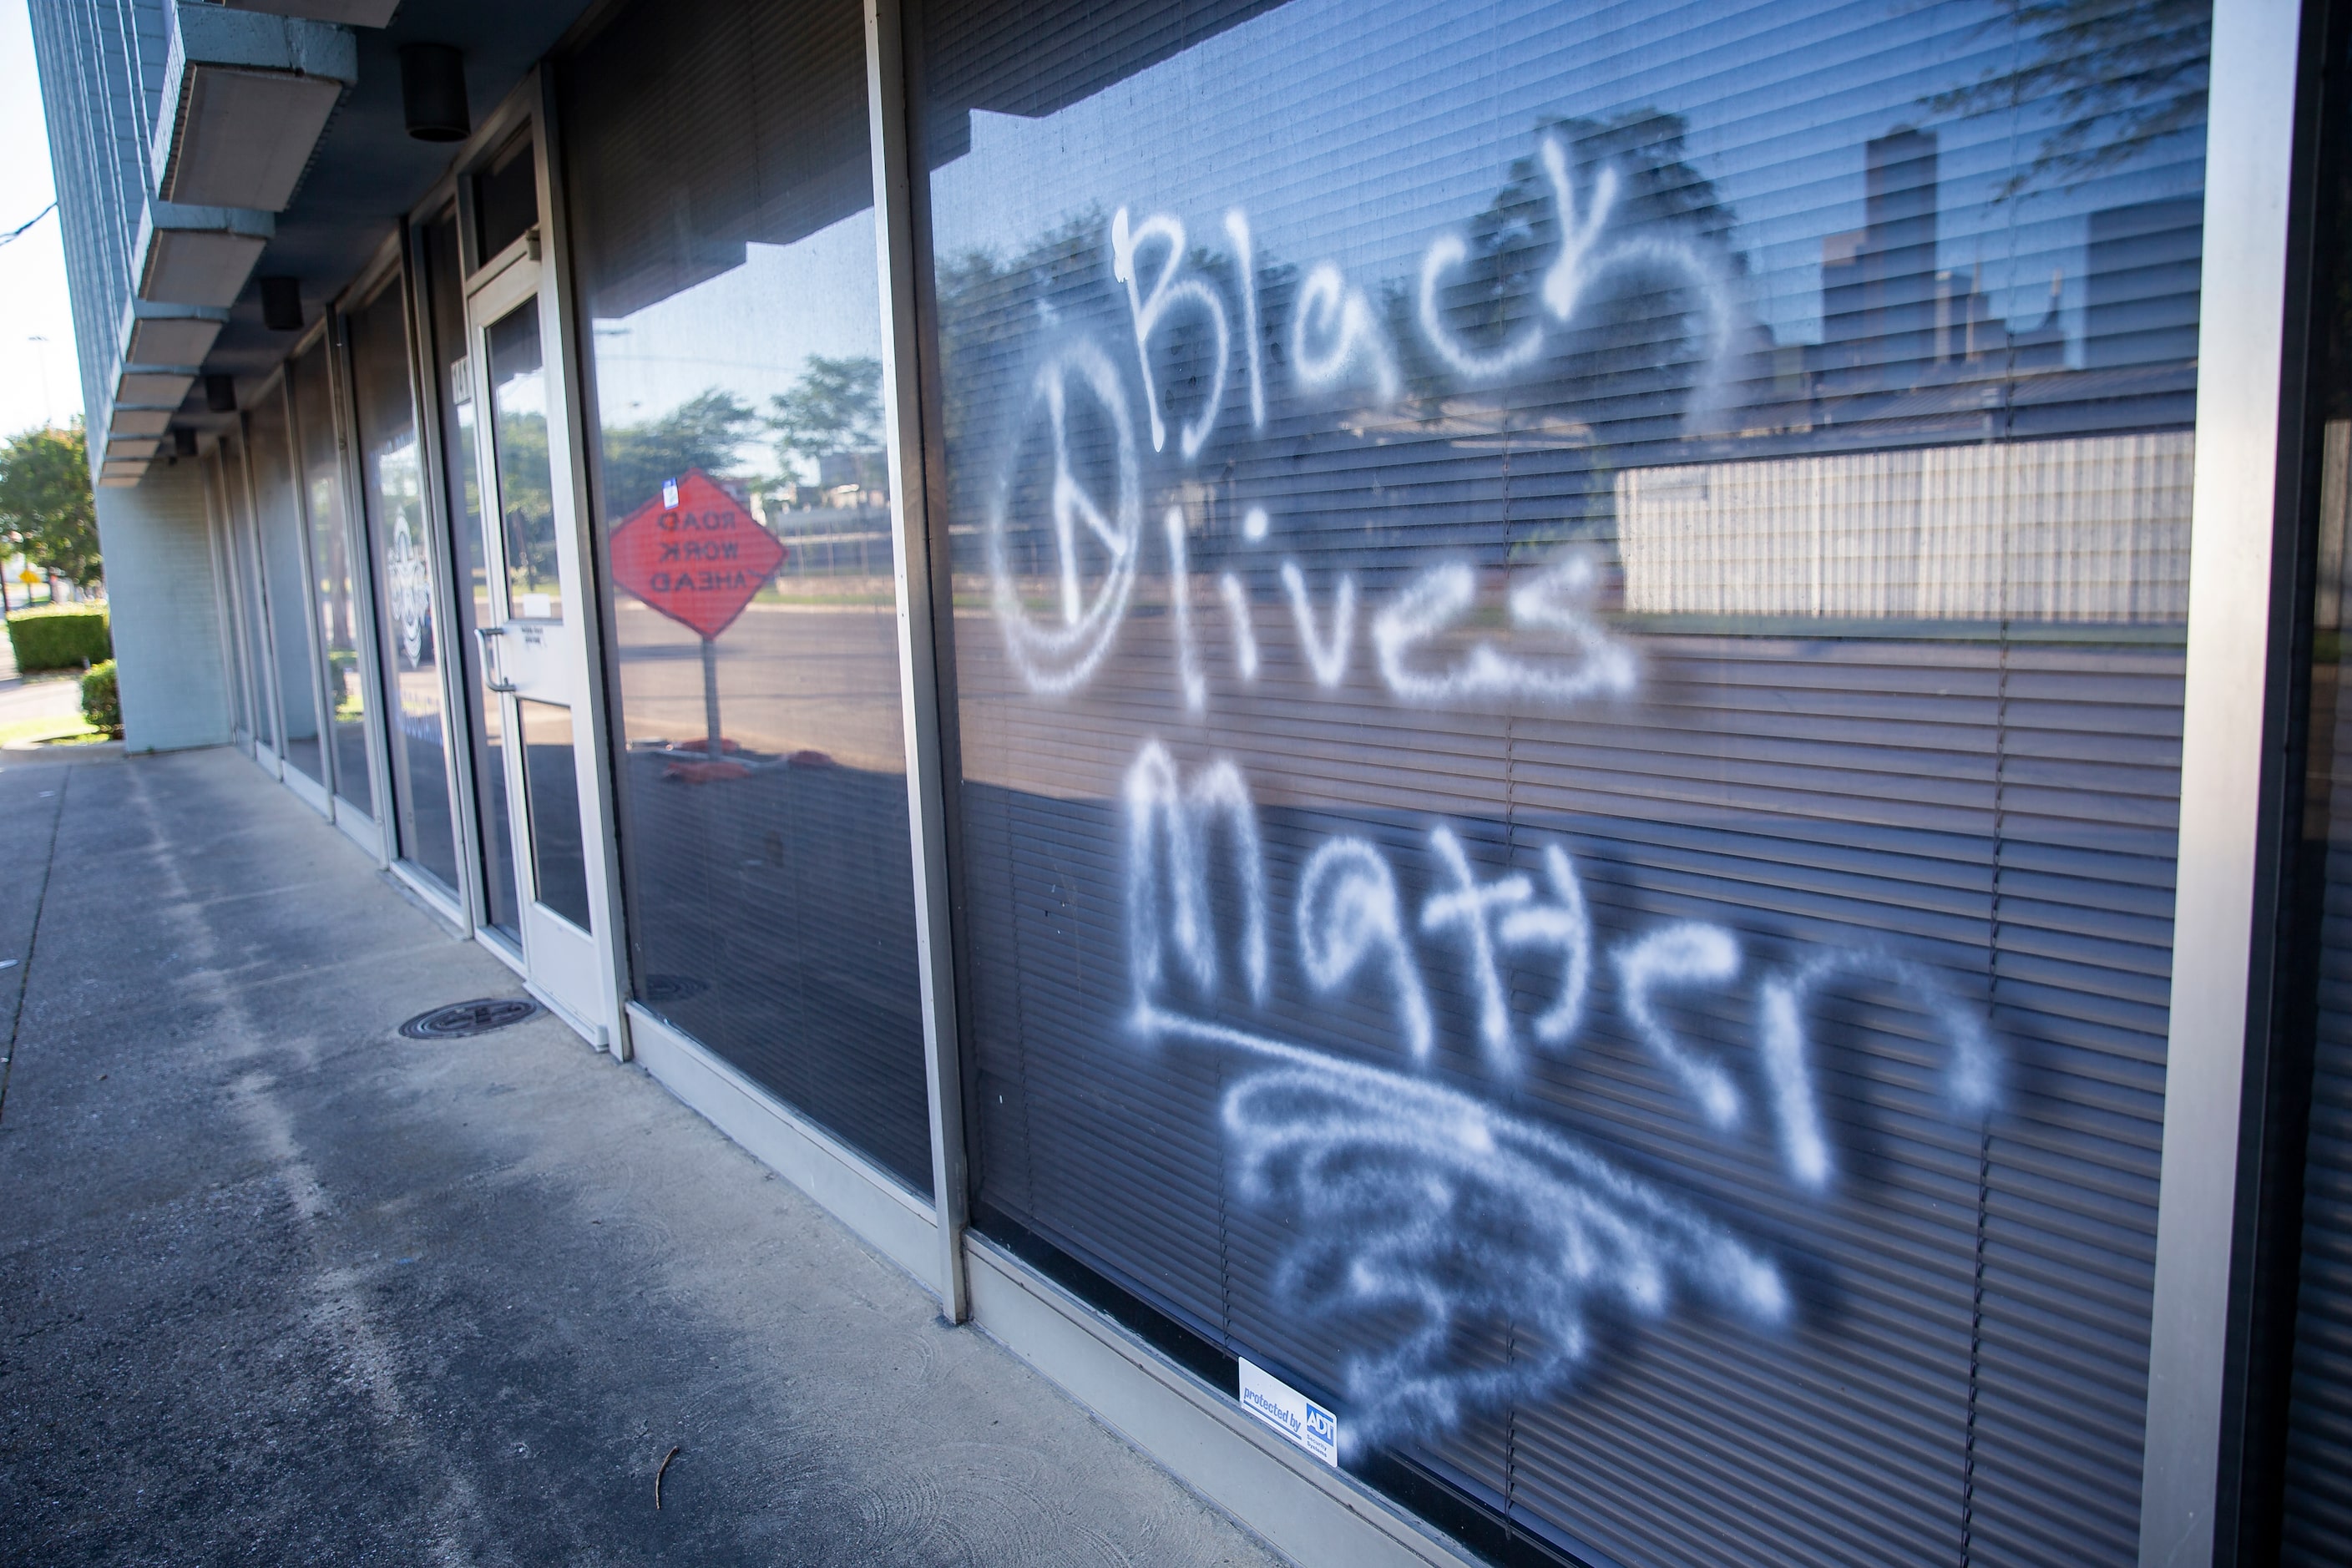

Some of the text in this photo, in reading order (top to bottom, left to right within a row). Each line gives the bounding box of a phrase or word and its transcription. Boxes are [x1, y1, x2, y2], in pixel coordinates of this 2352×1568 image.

[1110, 135, 1735, 459] Black
[1243, 1387, 1302, 1433] protected by
[1307, 1410, 1333, 1440] ADT
